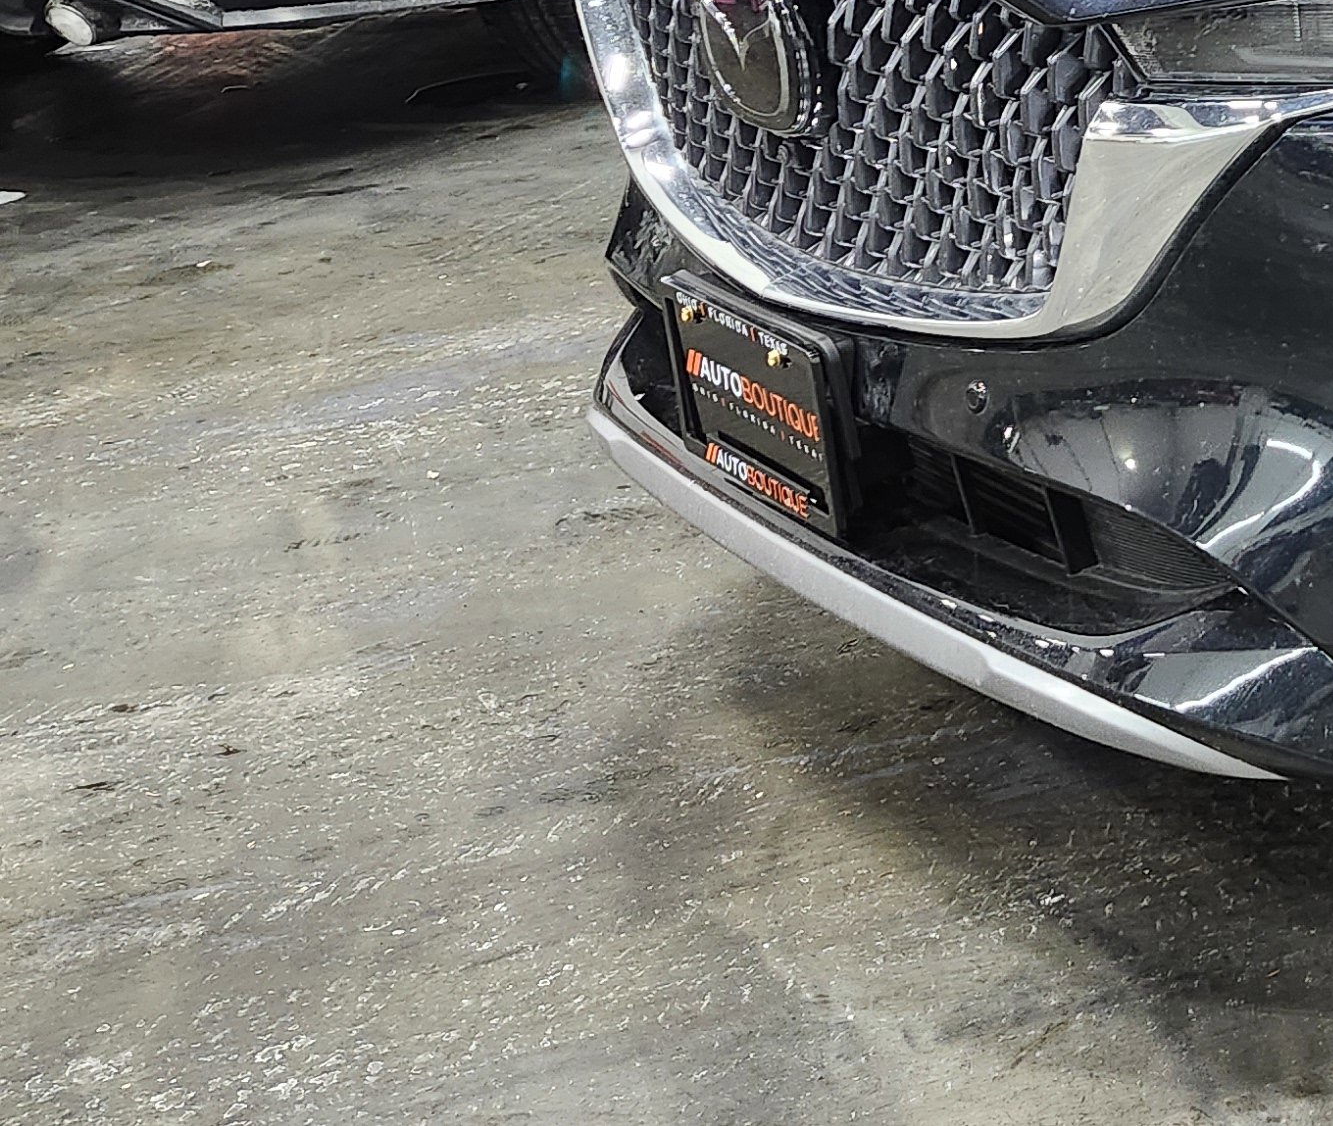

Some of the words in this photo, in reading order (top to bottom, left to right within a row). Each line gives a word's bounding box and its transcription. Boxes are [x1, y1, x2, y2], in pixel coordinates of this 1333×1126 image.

[707, 306, 749, 337] FLORIDA
[700, 356, 820, 442] AUTOBOUTIQUE
[729, 402, 775, 434] FLORIDA
[716, 449, 810, 519] AUTOBOUTIQUE
